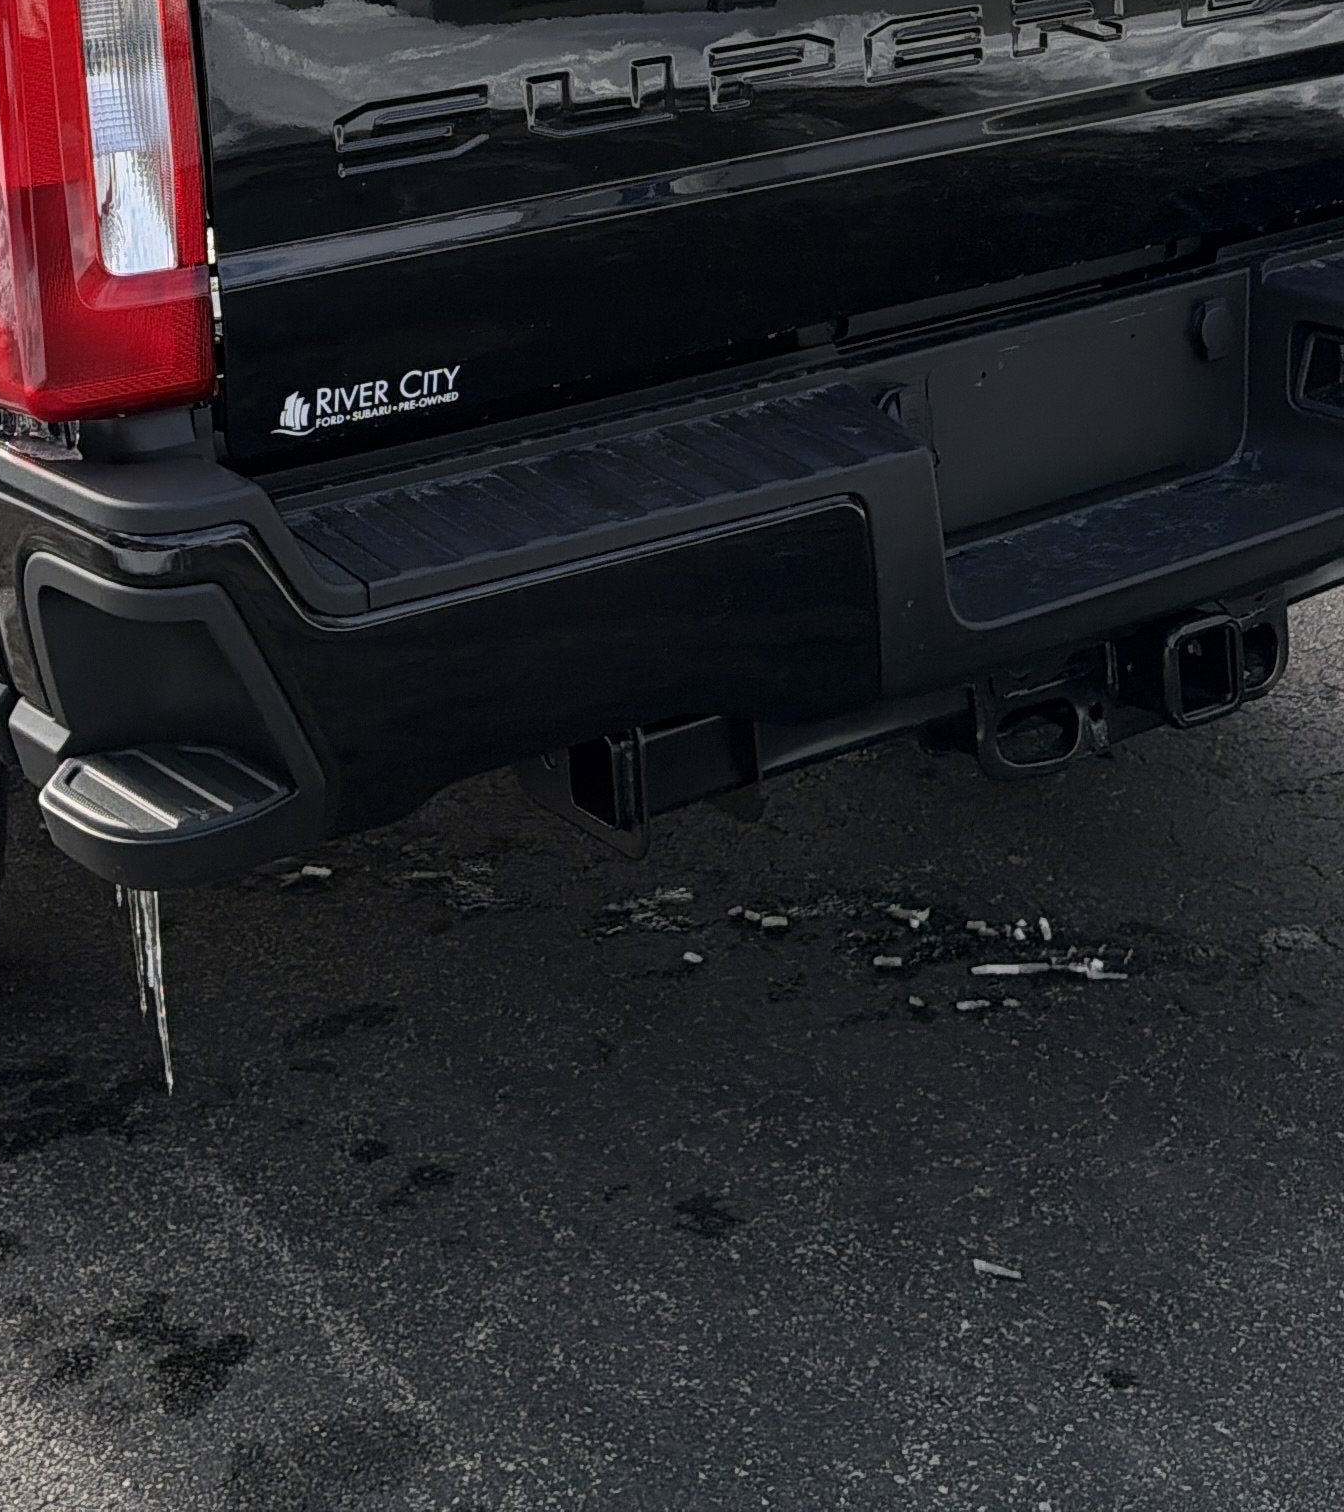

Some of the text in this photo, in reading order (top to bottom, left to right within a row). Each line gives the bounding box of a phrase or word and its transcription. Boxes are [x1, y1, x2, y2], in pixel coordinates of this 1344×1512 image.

[315, 391, 460, 429] FORD SUBARU PRE-OWNED
[316, 365, 461, 416] RIVER CITY
